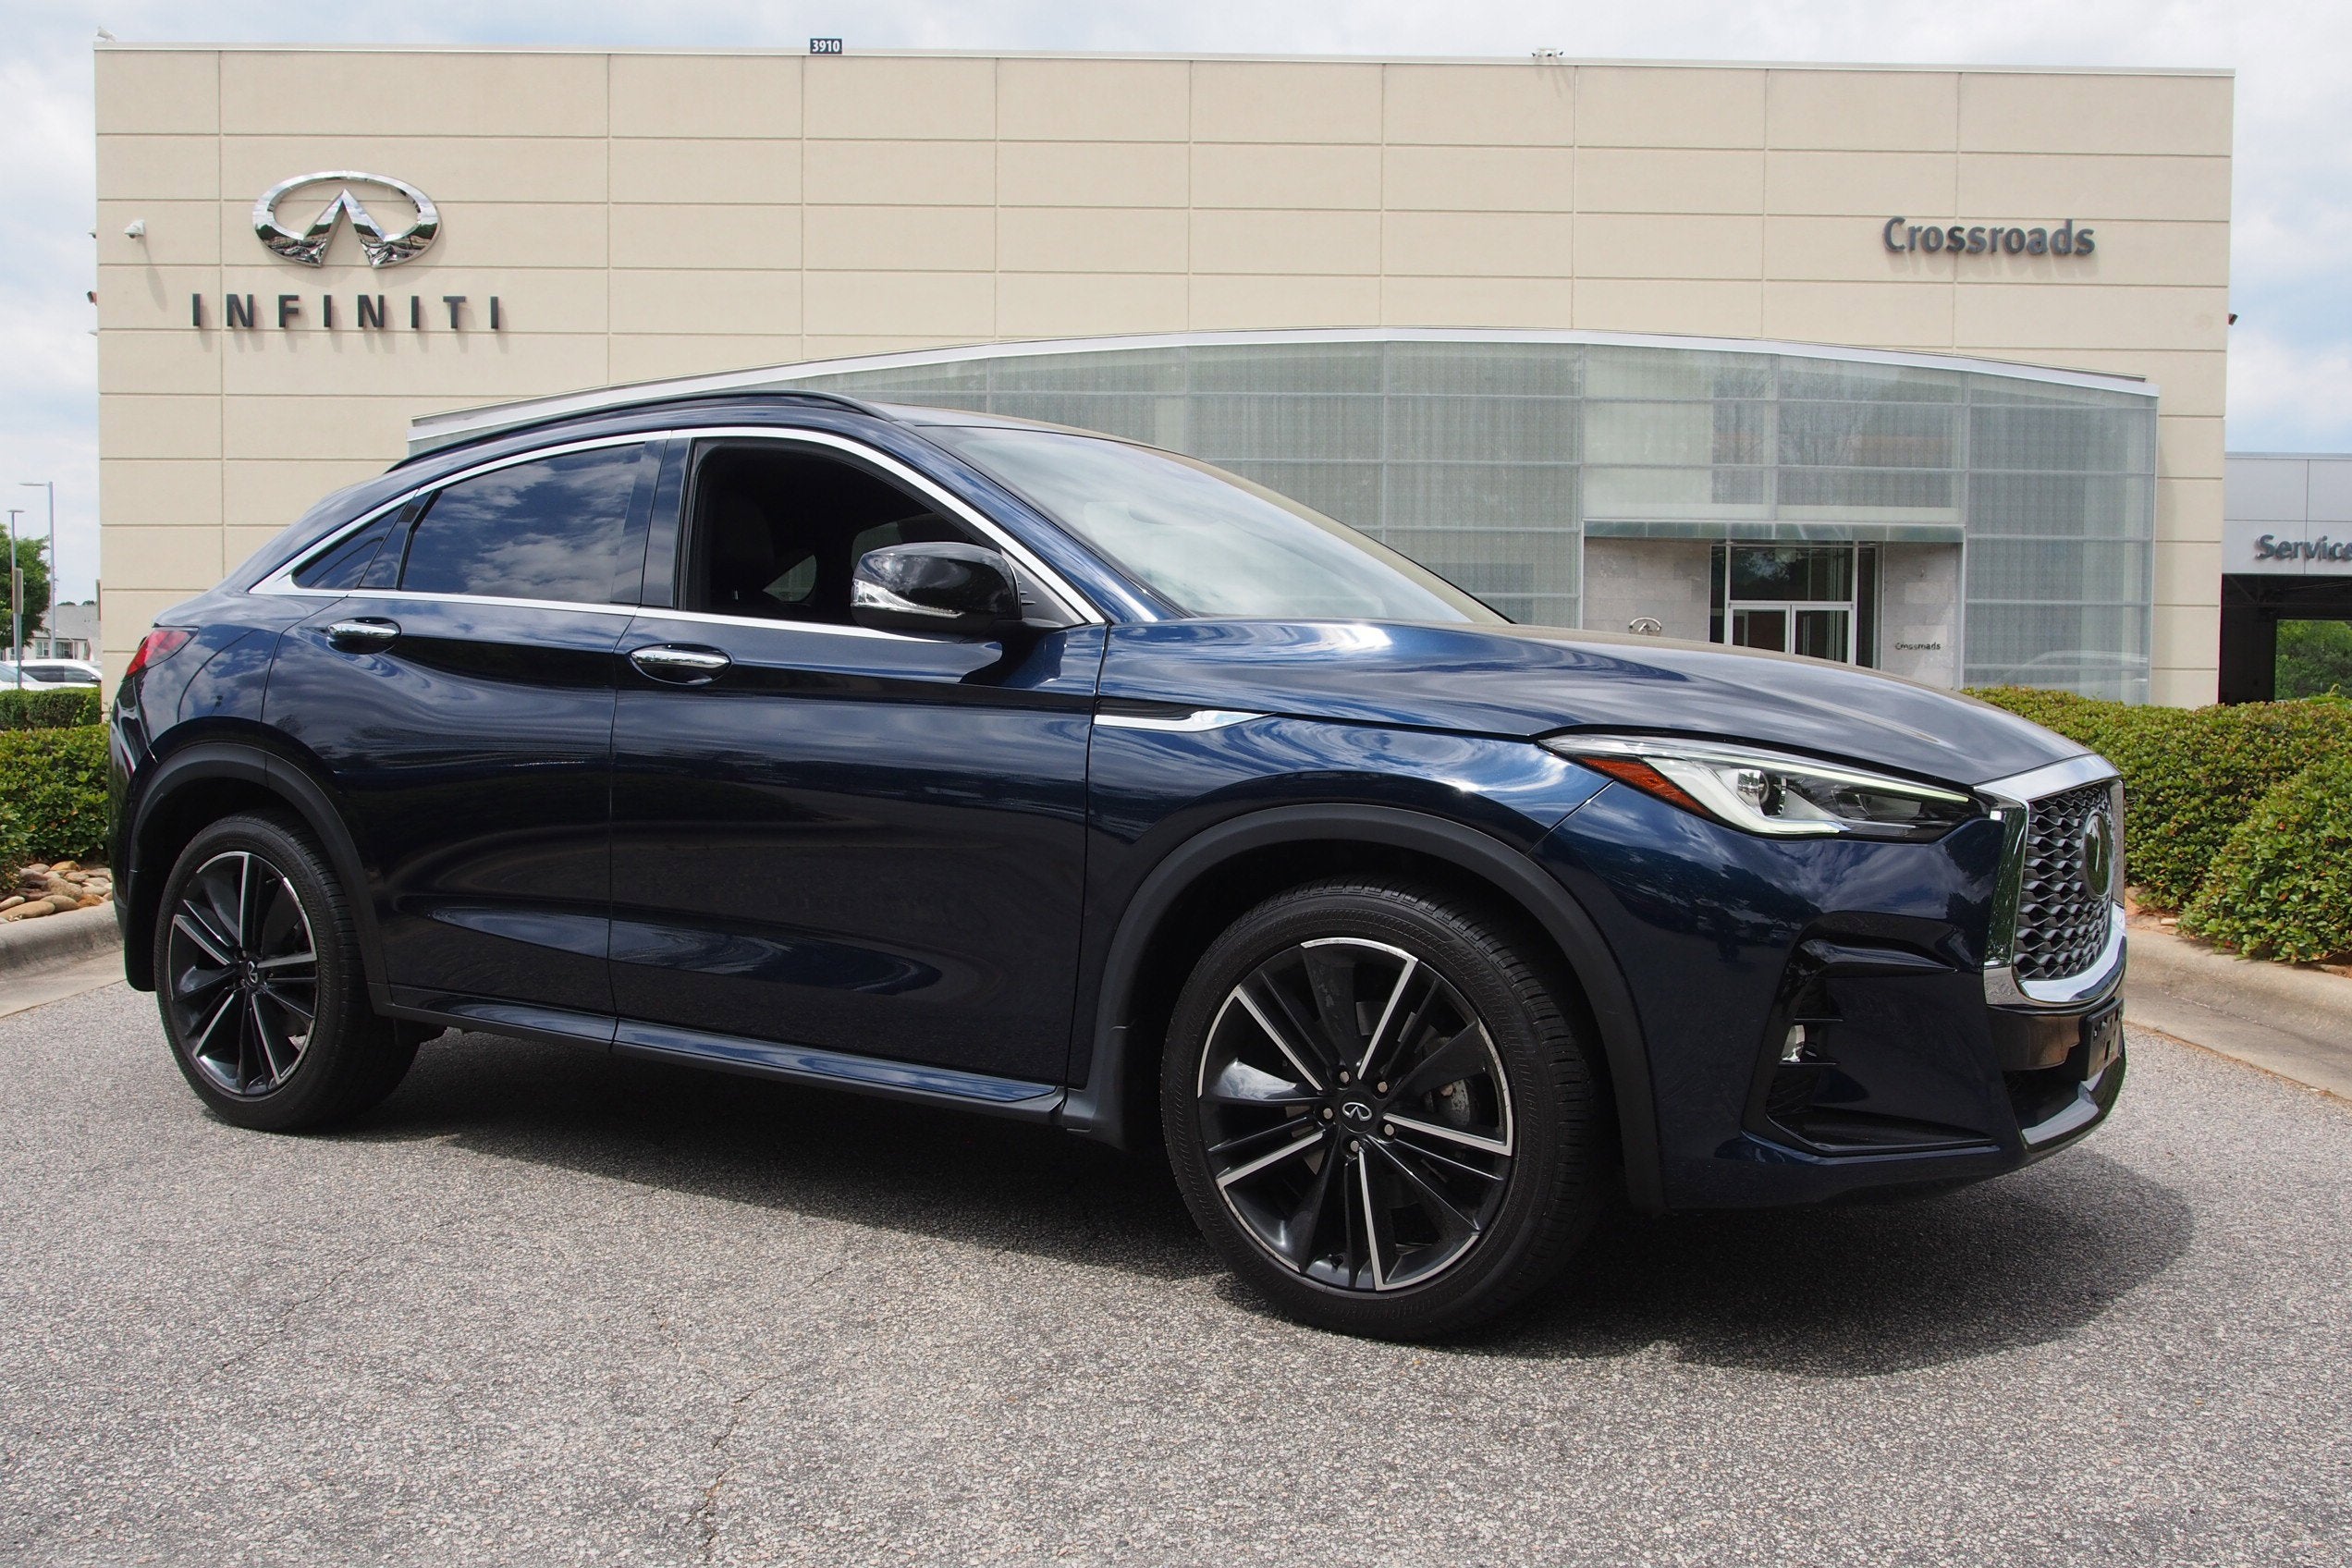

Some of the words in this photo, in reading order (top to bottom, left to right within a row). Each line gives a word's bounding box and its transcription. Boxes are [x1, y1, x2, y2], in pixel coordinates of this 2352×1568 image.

[812, 40, 840, 53] 3910
[1883, 216, 2096, 256] Crossroads
[192, 293, 499, 329] INFINITI
